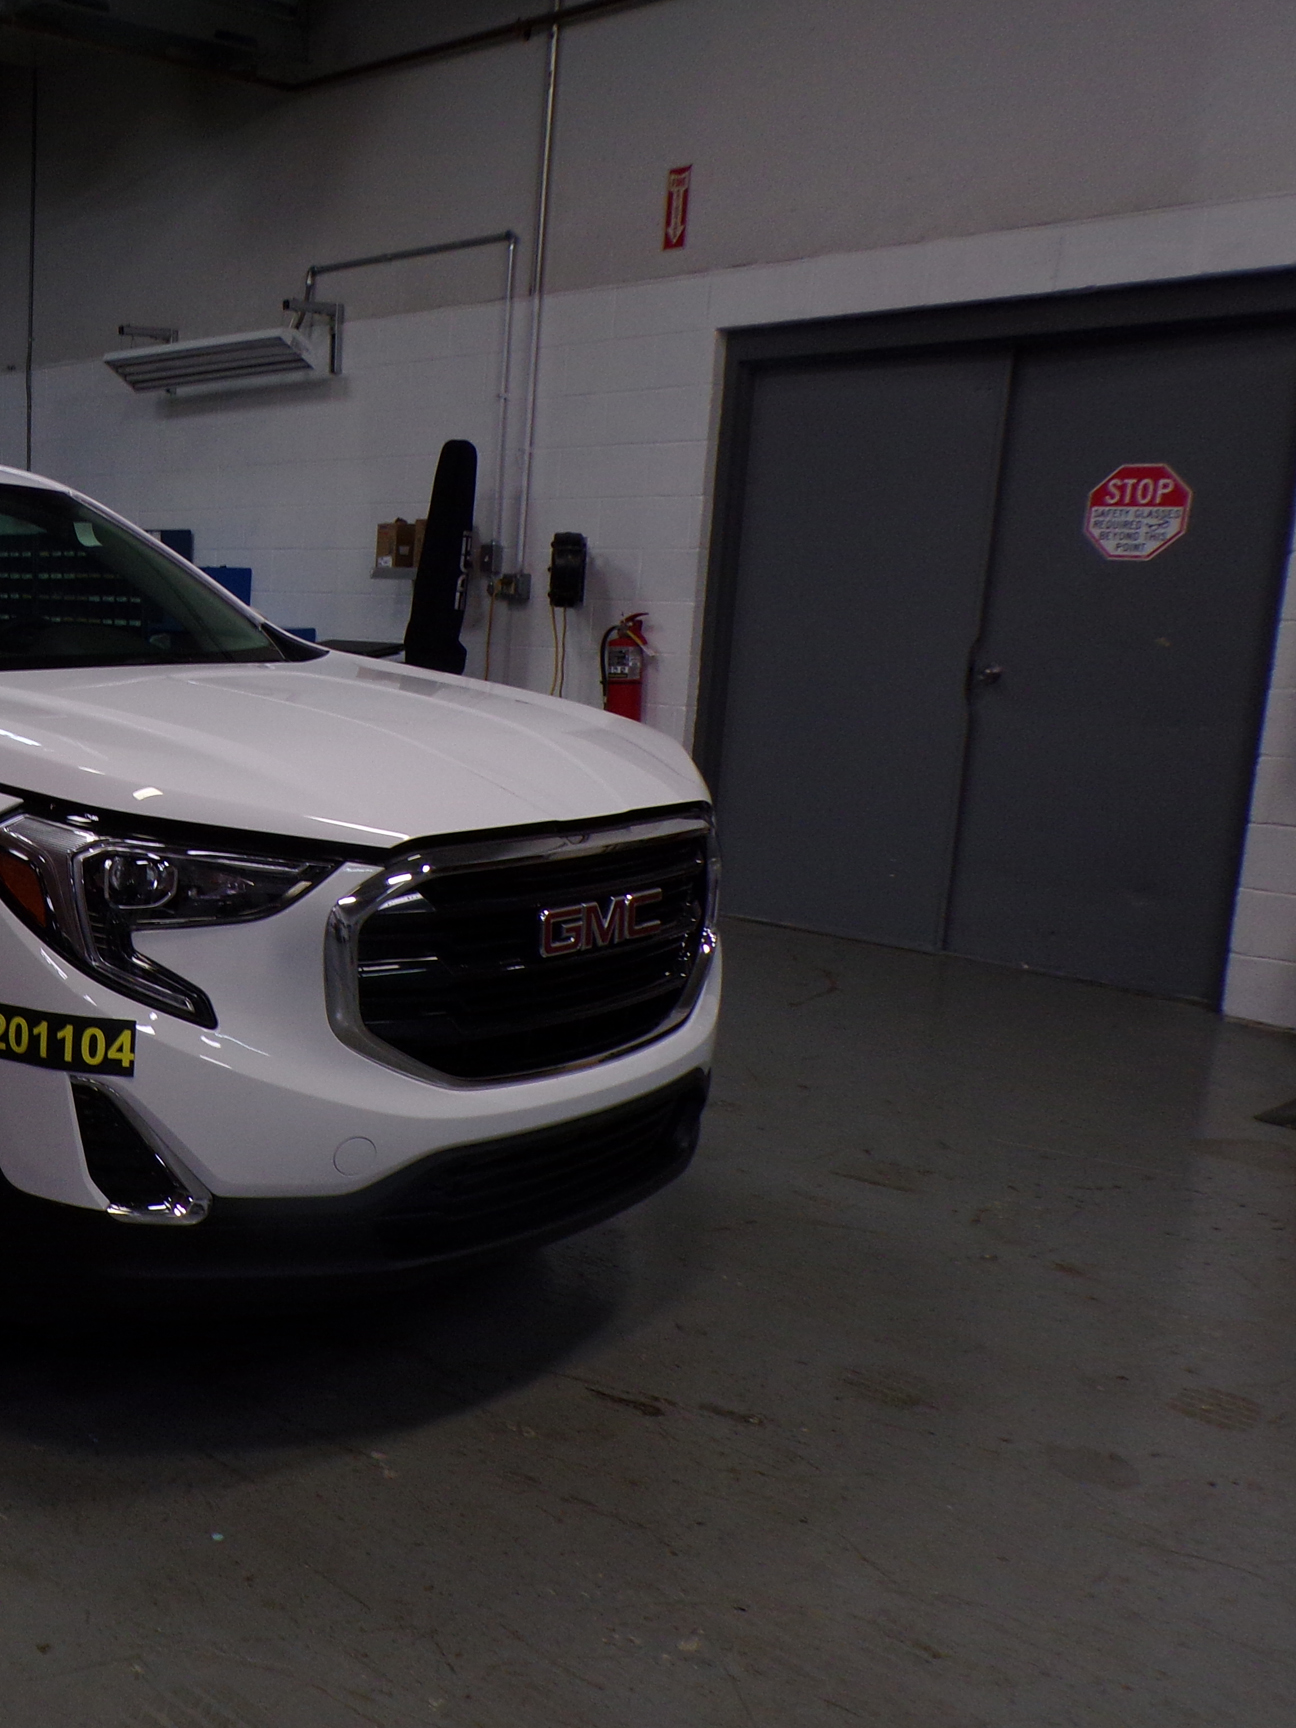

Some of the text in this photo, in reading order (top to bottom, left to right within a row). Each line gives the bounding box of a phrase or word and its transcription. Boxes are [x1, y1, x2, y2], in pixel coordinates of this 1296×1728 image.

[1105, 478, 1175, 504] STOP
[1093, 508, 1181, 519] SAFETY GLASSES
[1093, 520, 1142, 530] REQUIRED
[1099, 531, 1167, 541] BEYOND THIS
[1115, 543, 1146, 552] POINT
[539, 888, 662, 958] GMC
